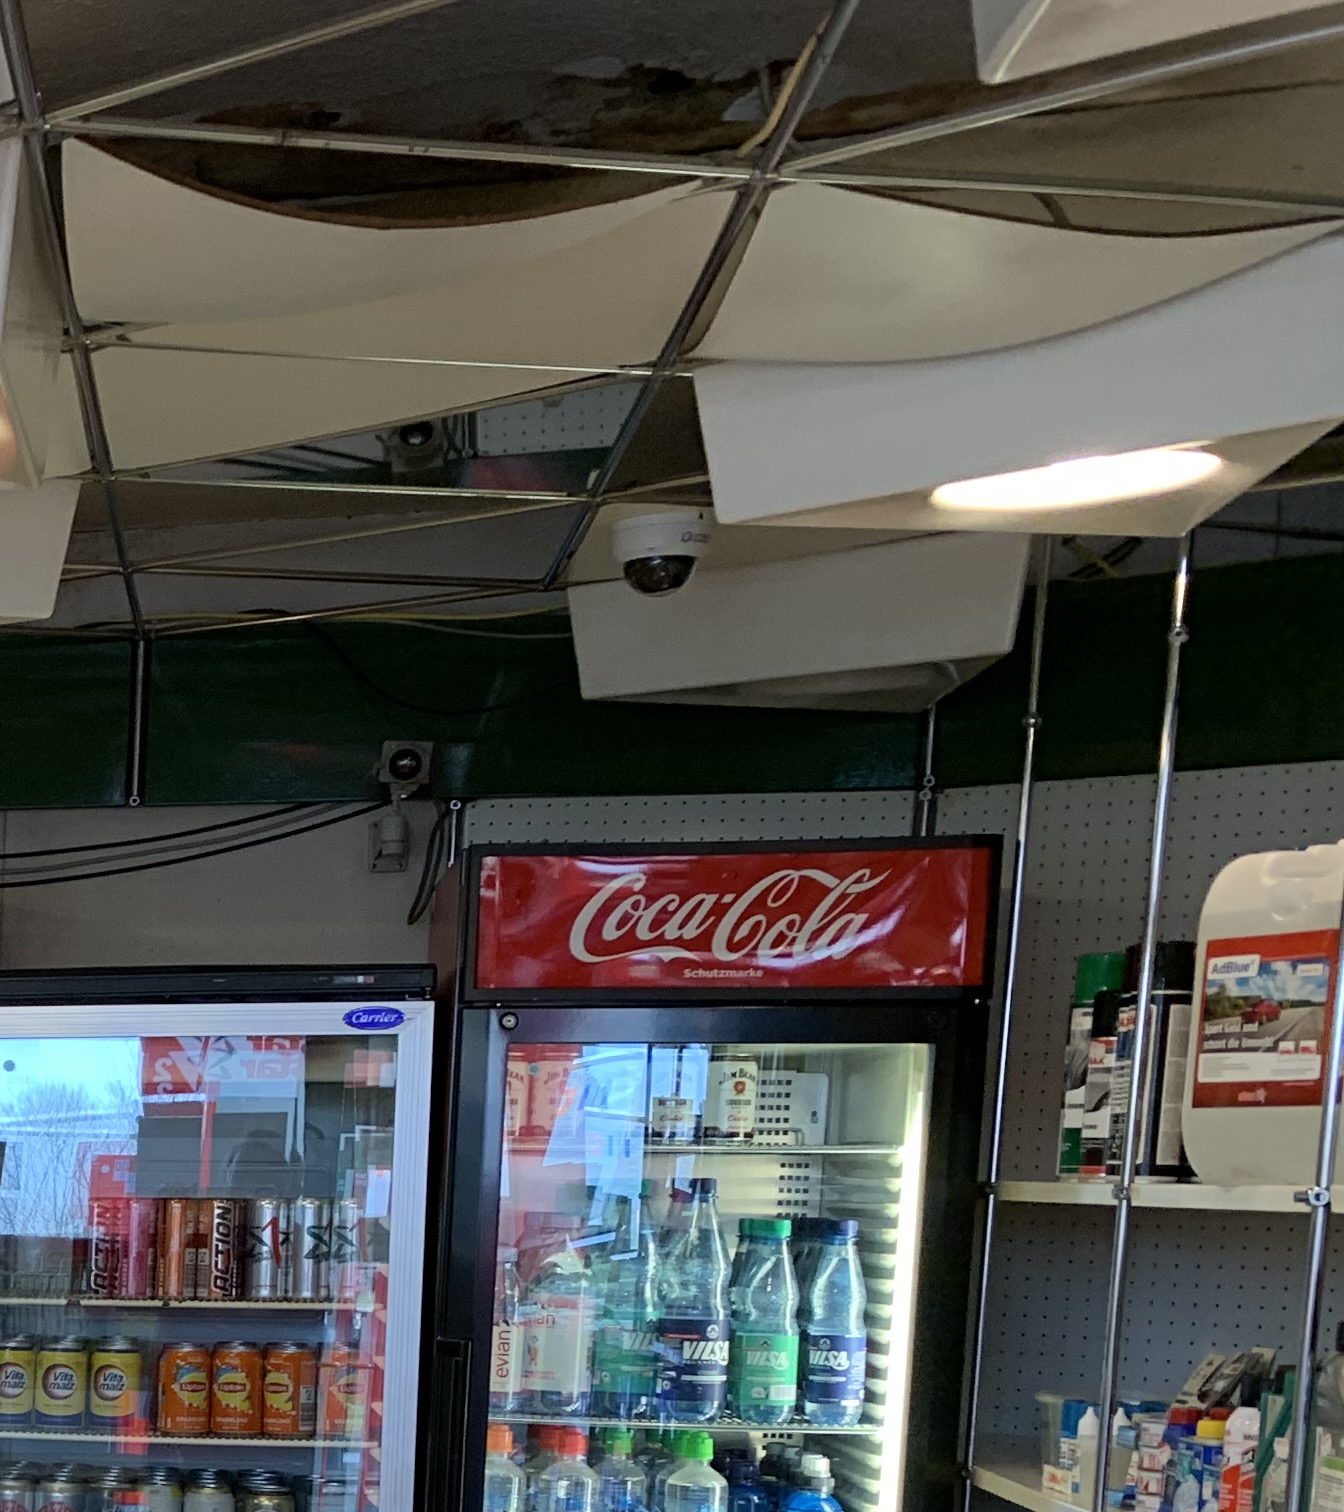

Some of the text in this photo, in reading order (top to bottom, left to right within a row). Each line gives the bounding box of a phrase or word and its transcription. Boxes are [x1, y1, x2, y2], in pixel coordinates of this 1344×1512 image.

[569, 867, 892, 964] Coca-Cola
[683, 967, 764, 979] Schutzmarke
[350, 1009, 399, 1025] Carrier
[496, 1330, 512, 1379] evian
[682, 1340, 729, 1366] VILSA
[746, 1350, 789, 1367] VILSA
[808, 1349, 850, 1369] VILSA
